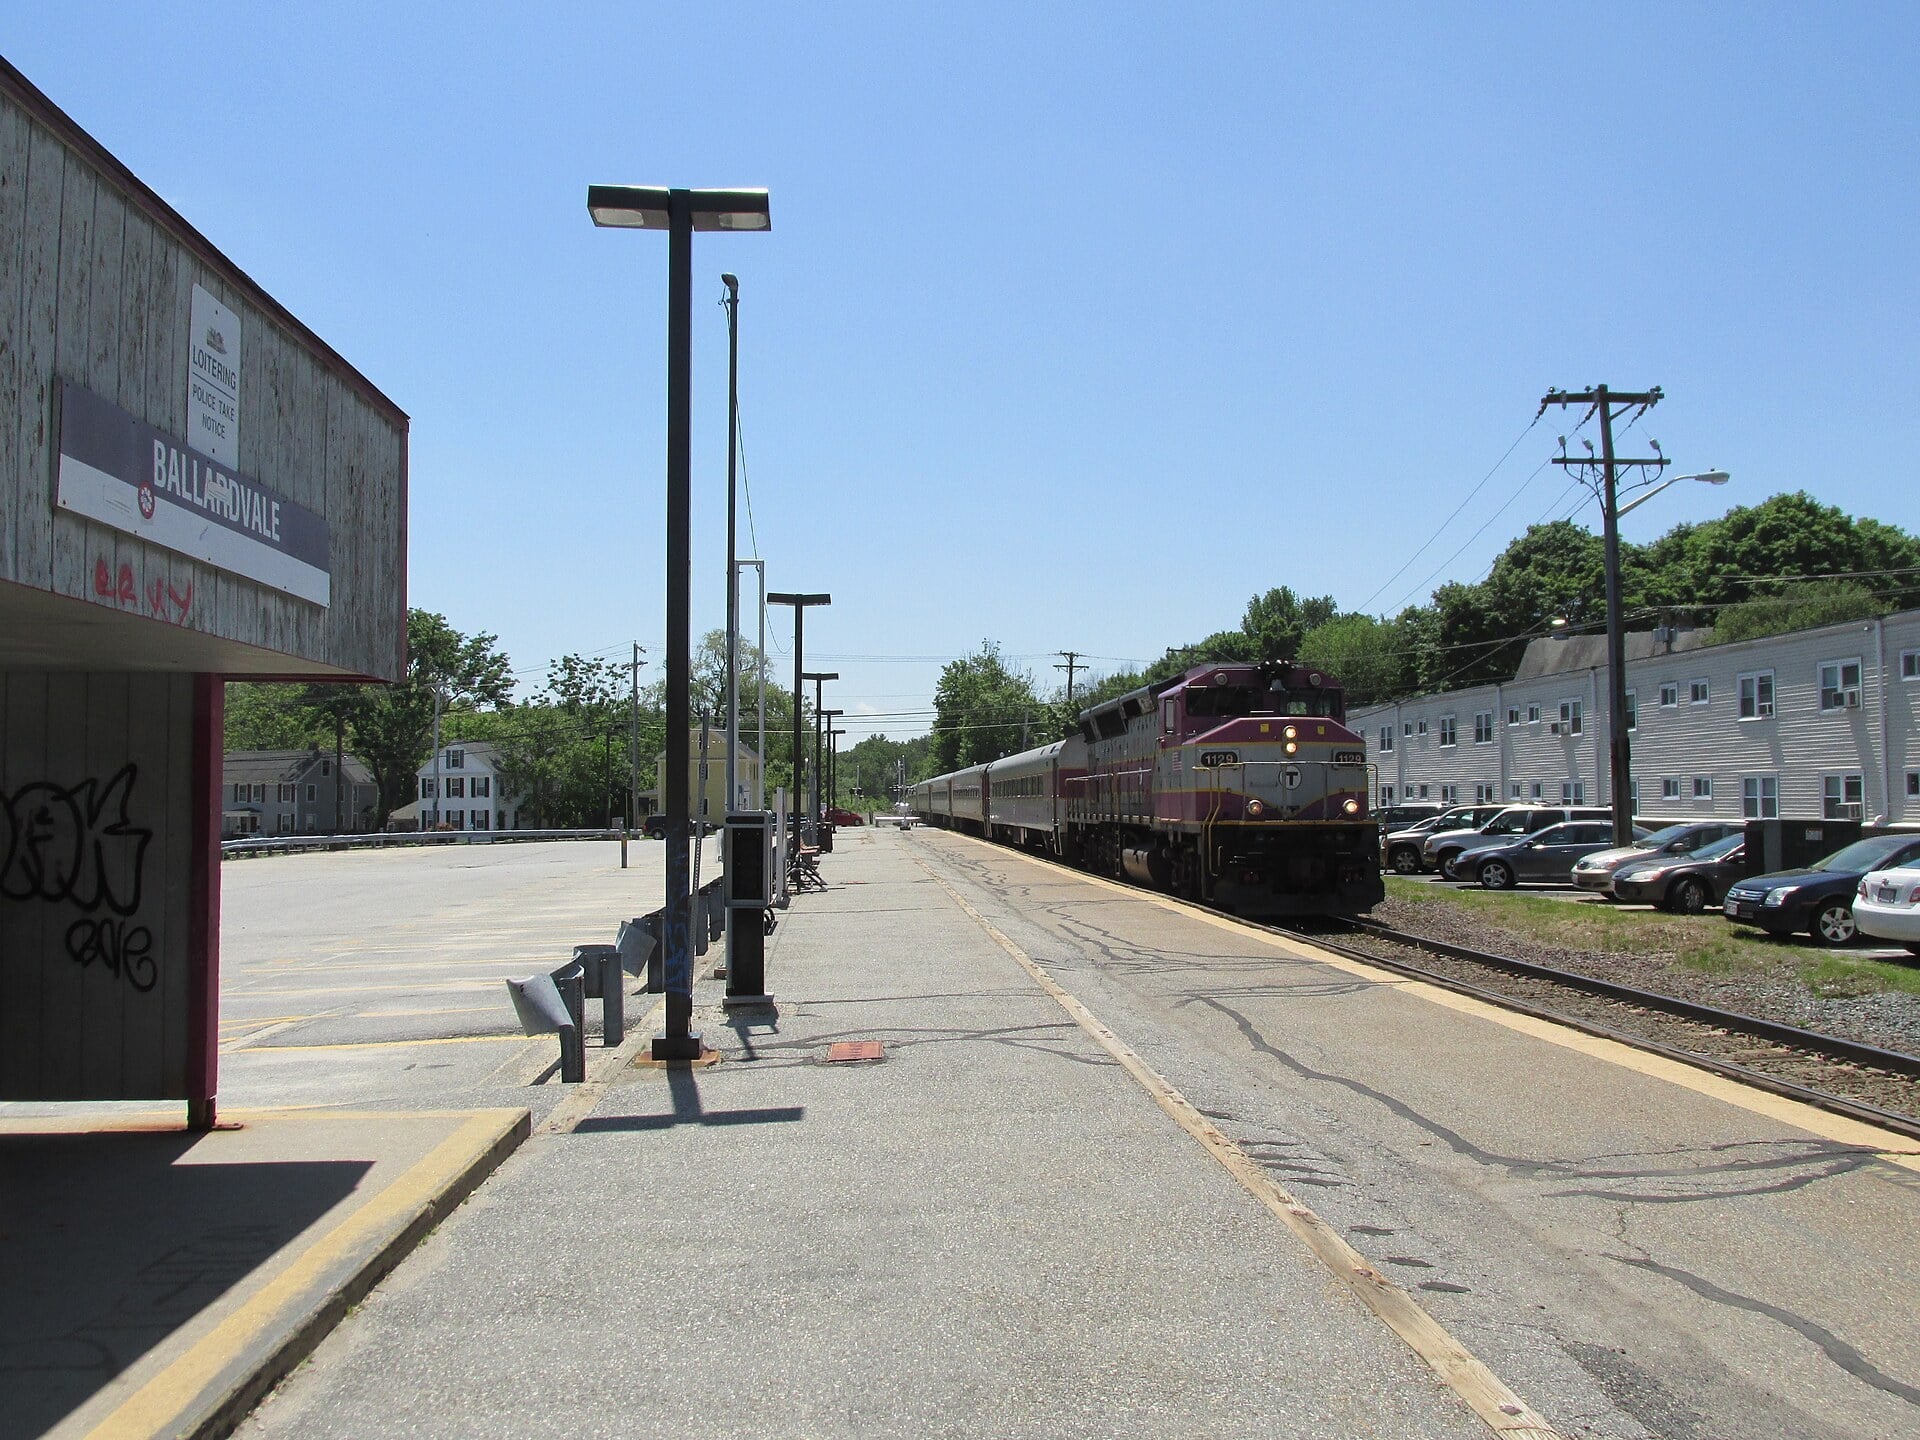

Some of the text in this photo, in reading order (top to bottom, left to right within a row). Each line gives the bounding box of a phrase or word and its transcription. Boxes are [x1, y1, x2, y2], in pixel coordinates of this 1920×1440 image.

[192, 344, 236, 390] LOITERING
[192, 384, 234, 422] POLICE TAKE
[202, 413, 225, 439] NOTICE
[153, 439, 280, 542] BALLARDVALE
[1205, 754, 1234, 765] 1129
[1338, 754, 1362, 764] 1129
[1285, 771, 1298, 786] T
